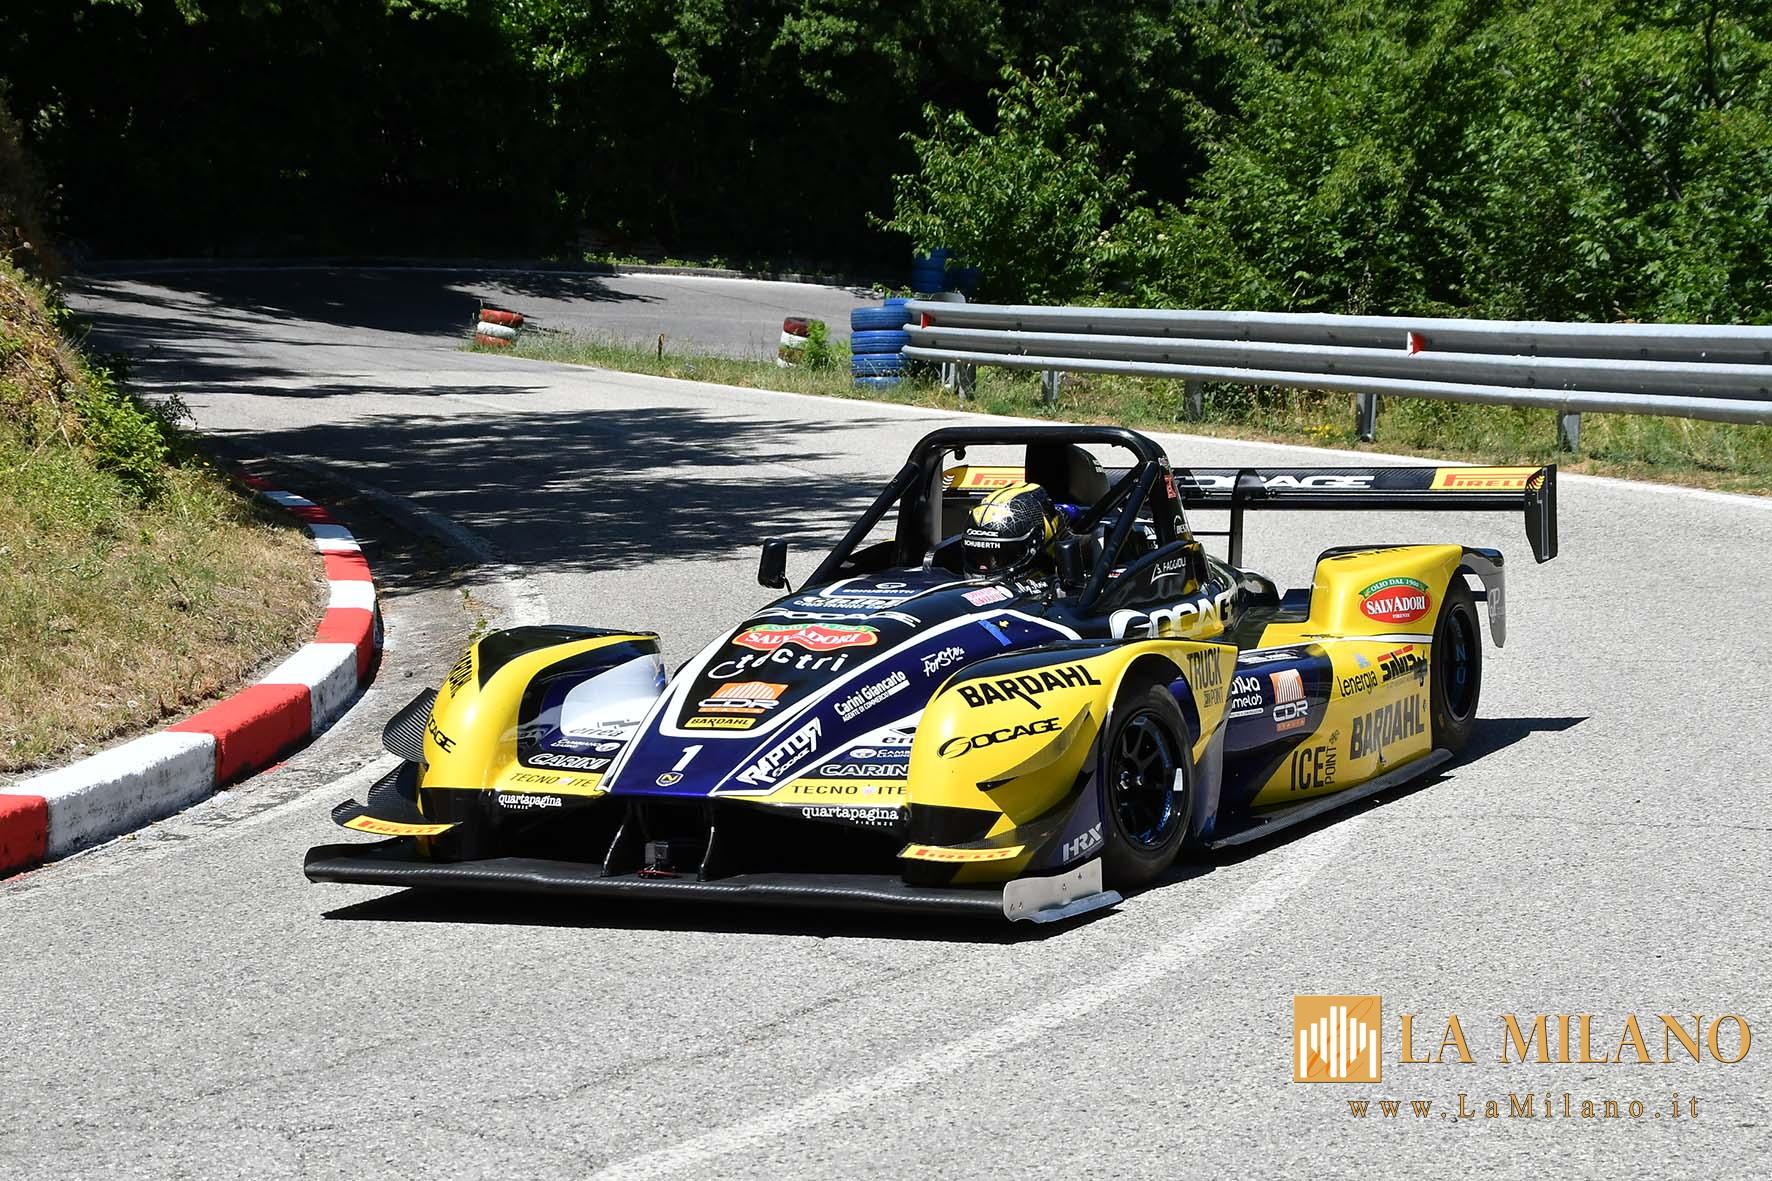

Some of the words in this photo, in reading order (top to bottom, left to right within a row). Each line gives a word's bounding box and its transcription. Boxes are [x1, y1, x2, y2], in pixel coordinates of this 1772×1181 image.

[1370, 580, 1389, 593] OLIO
[1388, 578, 1405, 586] DAL
[1366, 596, 1426, 616] SALVADORI
[957, 664, 1102, 710] BARDAHL
[1186, 646, 1222, 690] TRUCK
[833, 690, 866, 716] Carini
[860, 671, 907, 700] Giancarlo
[1272, 700, 1309, 723] CDR
[690, 718, 750, 727] BARDAHL
[939, 717, 1063, 760] SOCAGE
[1350, 692, 1425, 765] BARDAHL
[671, 744, 704, 771] 1
[1290, 745, 1326, 791] ICE
[1324, 745, 1337, 785] POINT
[498, 793, 562, 808] quartapagina
[801, 806, 899, 821] quartapagina
[1063, 822, 1102, 862] HRX
